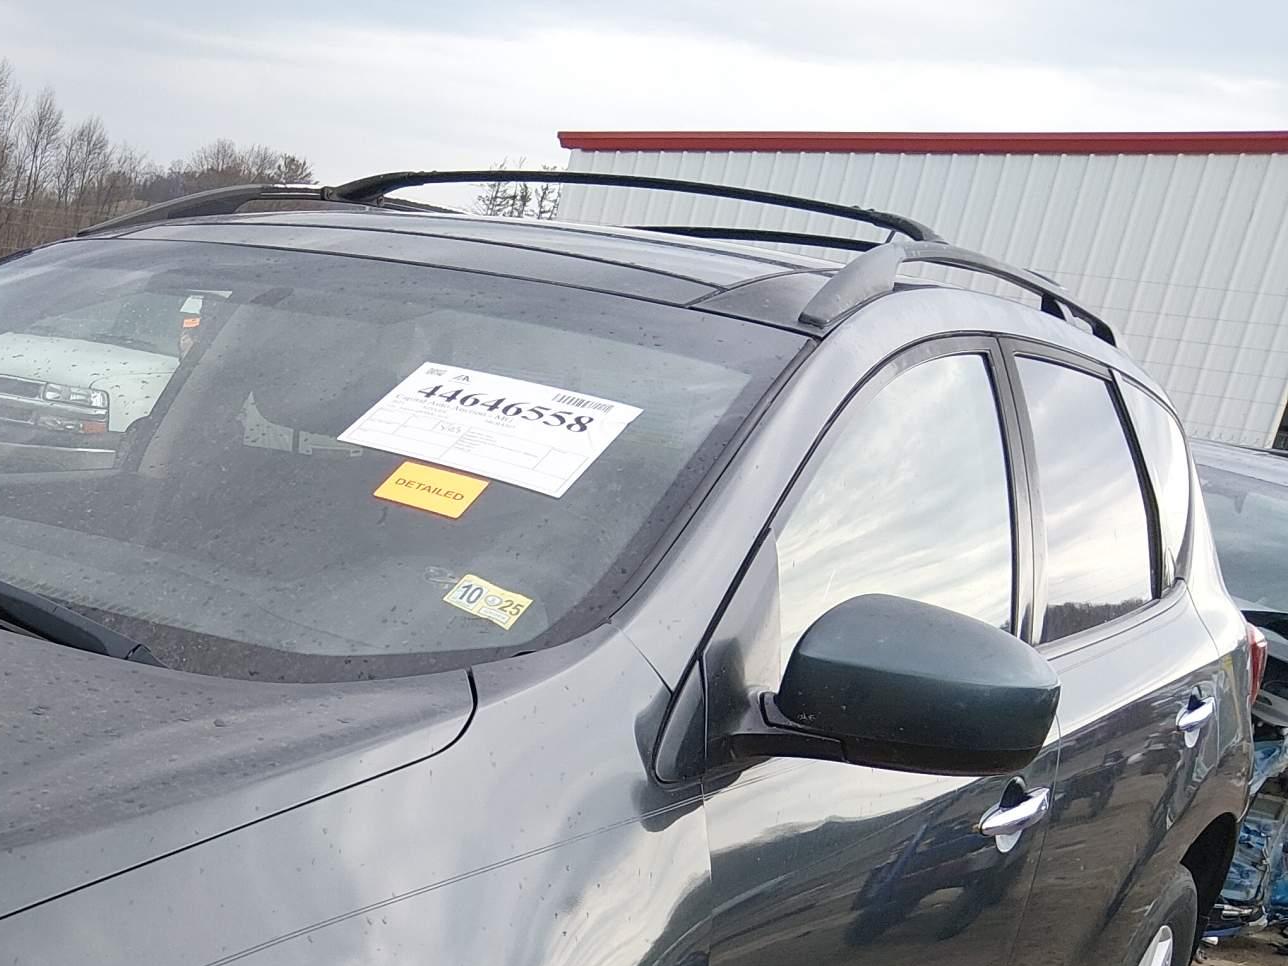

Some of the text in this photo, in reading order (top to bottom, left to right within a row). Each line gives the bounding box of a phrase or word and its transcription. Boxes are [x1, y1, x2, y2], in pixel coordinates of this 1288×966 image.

[417, 384, 595, 434] 44646558
[394, 477, 465, 502] DETAILED
[458, 583, 484, 604] 10
[497, 599, 524, 616] 25
